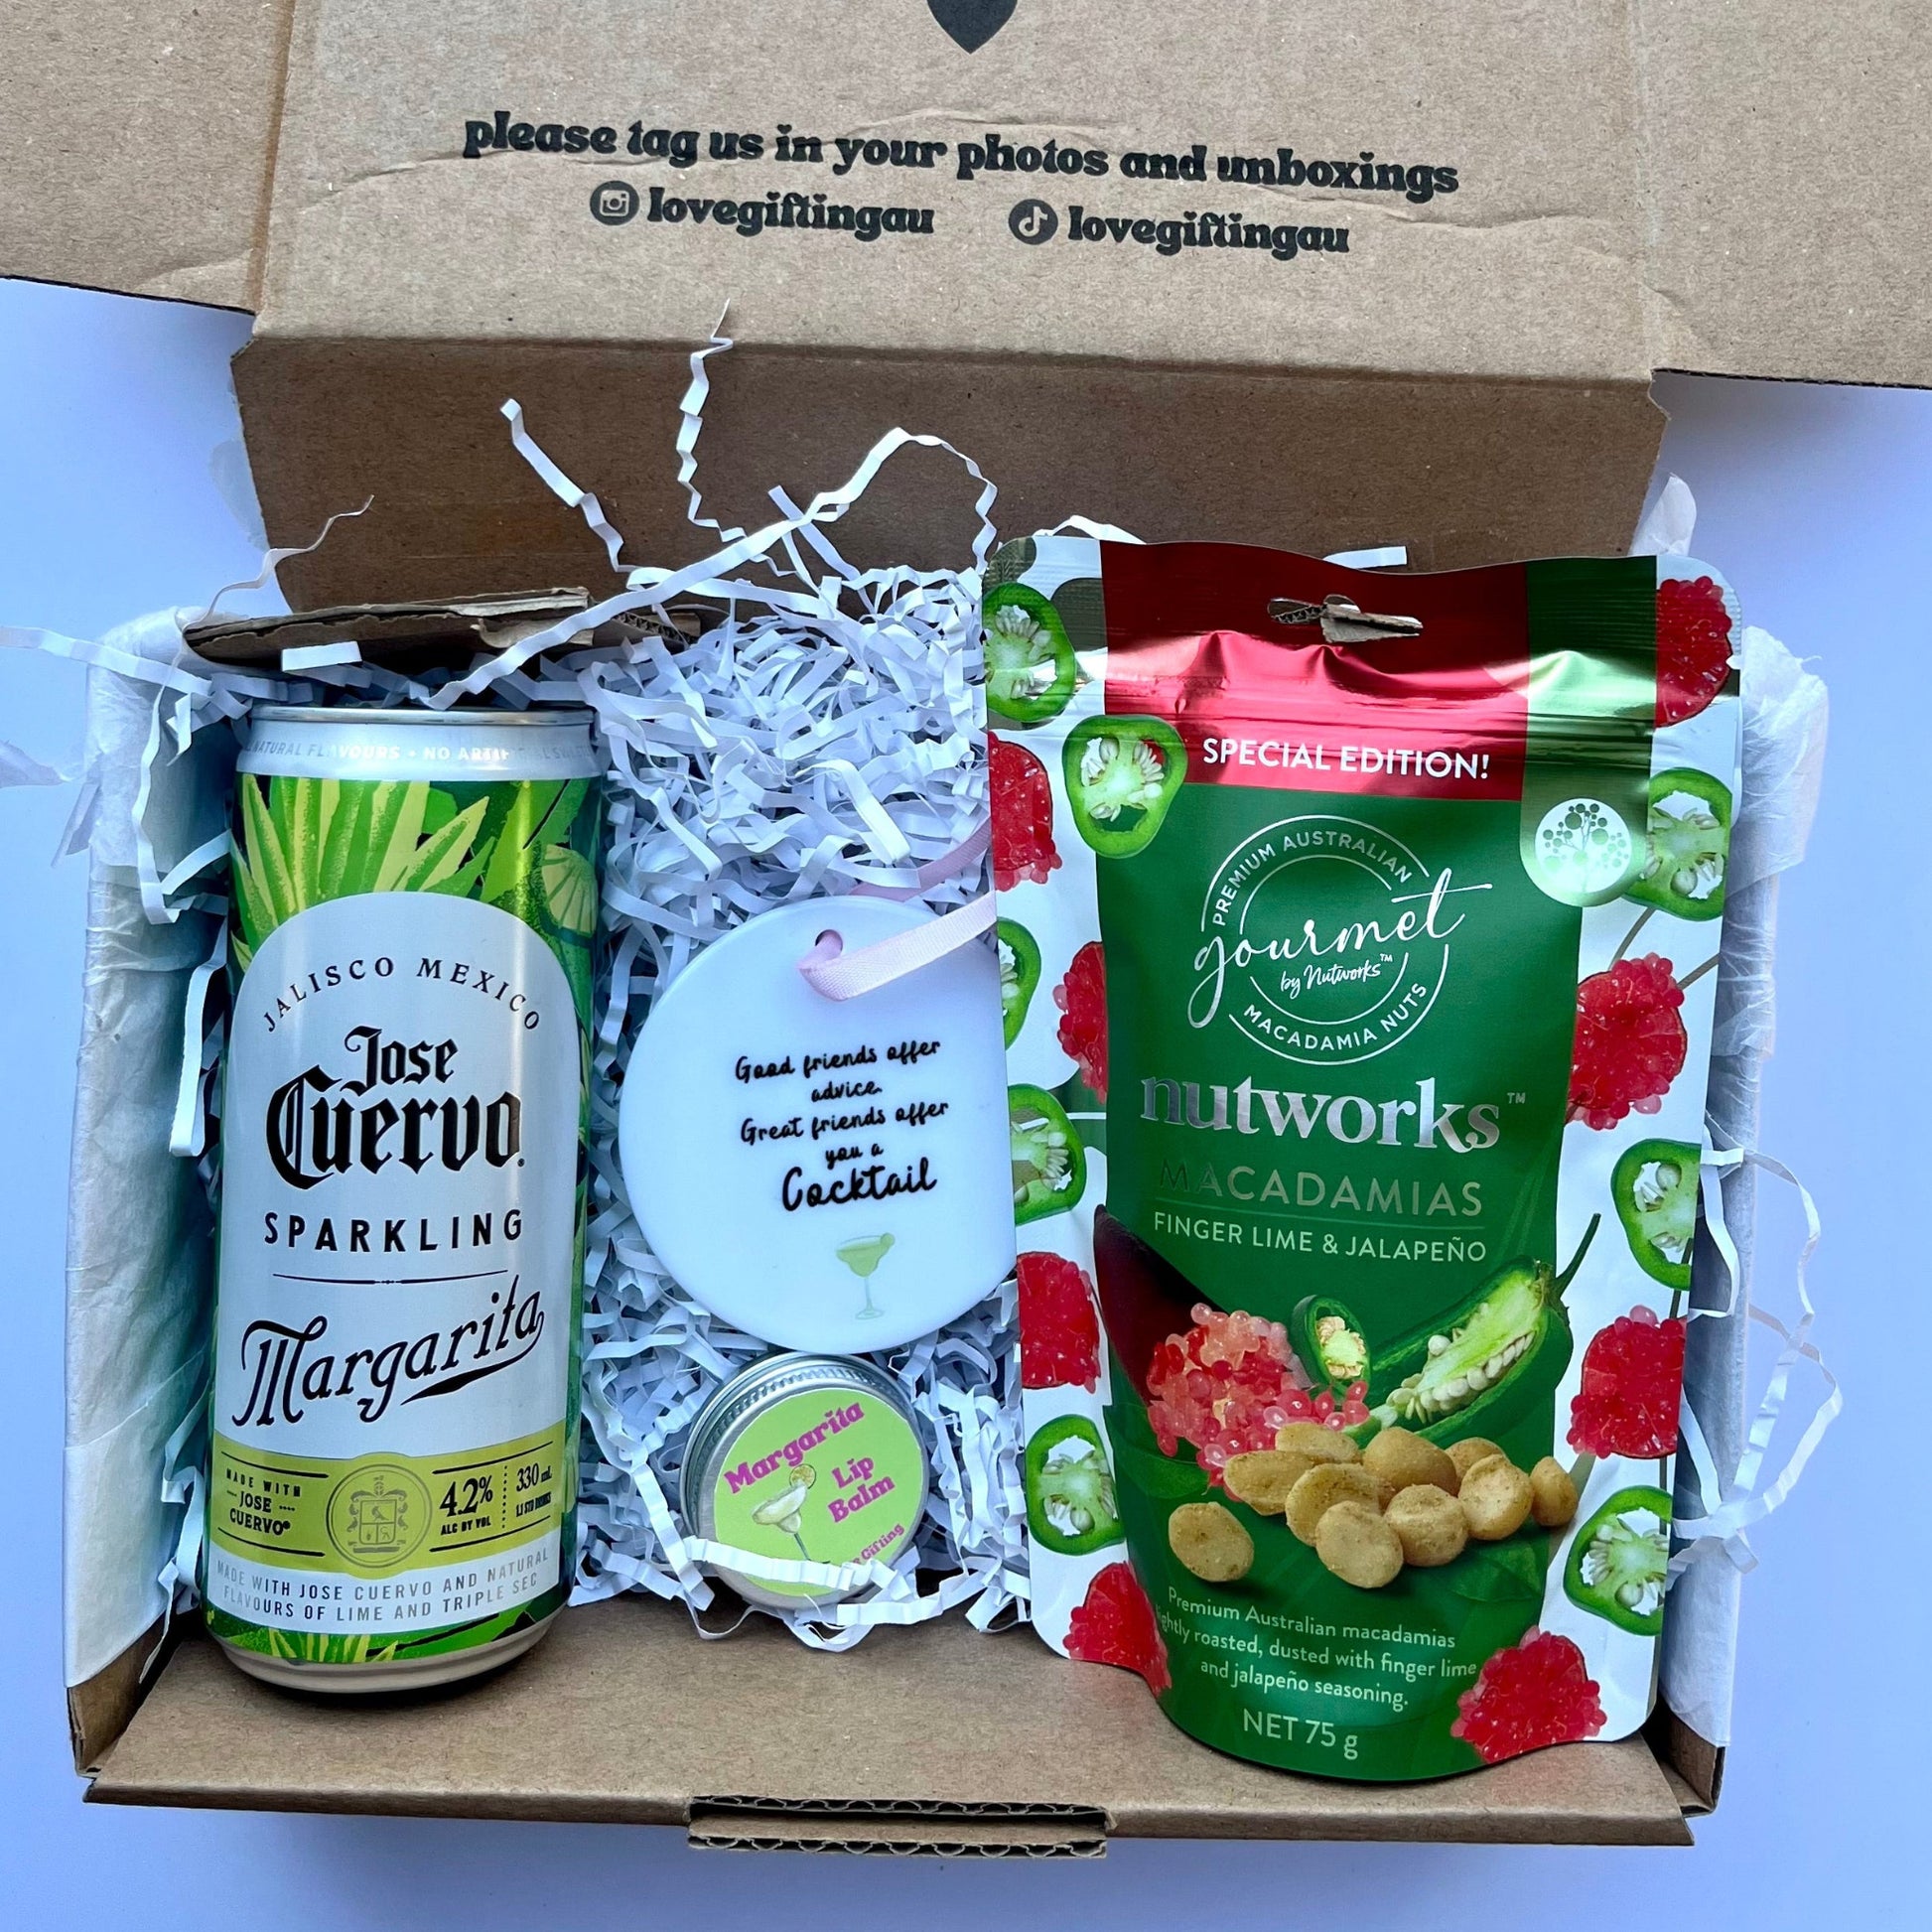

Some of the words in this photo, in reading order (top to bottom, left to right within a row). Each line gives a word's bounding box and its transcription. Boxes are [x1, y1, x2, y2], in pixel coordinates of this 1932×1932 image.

[464, 110, 617, 158] please
[627, 120, 700, 168] tag
[709, 131, 763, 161] us
[775, 123, 823, 162] in
[833, 136, 947, 175] your
[956, 133, 1109, 181] photos
[1120, 145, 1207, 182] and
[1217, 148, 1459, 204] unboxings
[648, 187, 934, 241] lovegiftingau
[1068, 206, 1349, 260] lovegiftingau
[423, 746, 451, 760] NO
[1202, 738, 1331, 770] SPECIAL
[1339, 746, 1490, 779] EDITION!
[1212, 843, 1277, 926] PREMIUM
[1282, 830, 1413, 883] AUSTRALIAN
[1187, 867, 1493, 1029] gourmet
[264, 956, 395, 1033] JALISCO
[417, 957, 540, 1031] MEXICO
[1280, 970, 1302, 999] by
[1304, 959, 1381, 990] Nutworks
[1243, 1003, 1378, 1051] MACADAMIA
[1380, 983, 1428, 1033] NUTS
[340, 1026, 458, 1096] Jose
[736, 1056, 795, 1083] Good
[804, 1045, 878, 1078] friends
[887, 1040, 941, 1064] offer
[266, 1064, 522, 1189] Cuervo
[741, 1118, 804, 1146] Great
[811, 1106, 886, 1140] friends
[896, 1102, 948, 1126] offer
[1140, 1075, 1500, 1154] nutworks
[825, 1145, 863, 1170] you
[871, 1143, 884, 1157] a
[782, 1157, 938, 1211] Cocktail
[1160, 1158, 1483, 1217] MACADAMIAS
[264, 1208, 522, 1253] SPARKLING
[1154, 1210, 1243, 1244] FINGER
[1252, 1225, 1312, 1253] LIME
[1322, 1233, 1338, 1255] &
[1345, 1236, 1487, 1263] JALAPEÑO
[231, 1274, 545, 1428] Margarita
[724, 1402, 866, 1494] Margarita
[831, 1455, 875, 1489] Lip
[226, 1467, 254, 1488] MADE
[263, 1480, 301, 1497] WITH
[239, 1490, 272, 1513] JOSE
[440, 1474, 493, 1517] 4.2%
[516, 1462, 539, 1492] 330
[827, 1475, 895, 1523] Balm
[441, 1523, 458, 1536] ALC
[462, 1520, 473, 1532] BY
[476, 1516, 491, 1529] VOL
[861, 1523, 905, 1560] Gifting
[216, 1561, 245, 1587] MADE
[252, 1578, 291, 1596] WITH
[300, 1585, 343, 1600] JOSE
[354, 1581, 432, 1601] CUERVO
[443, 1575, 478, 1593] AND
[487, 1547, 549, 1584] NATURAL
[223, 1585, 294, 1618] FLAVOURS
[304, 1604, 326, 1621] OF
[337, 1606, 382, 1621] LIME
[394, 1601, 432, 1619] AND
[443, 1587, 504, 1613] TRIPLE
[512, 1572, 537, 1594] SEC
[1169, 1586, 1240, 1621] Premium
[1245, 1605, 1336, 1638] Australian
[1343, 1623, 1456, 1649] macadamias
[1194, 1629, 1263, 1659] roasted,
[1269, 1639, 1329, 1665] dusted
[1335, 1648, 1375, 1671] with
[1381, 1652, 1436, 1683] finger
[1441, 1658, 1477, 1678] lime
[1200, 1658, 1229, 1679] and
[1230, 1663, 1310, 1695] jalapeño
[1314, 1679, 1409, 1713] seasoning.
[1243, 1709, 1299, 1741] NET
[1305, 1720, 1336, 1748] 75
[1343, 1734, 1359, 1761] g
